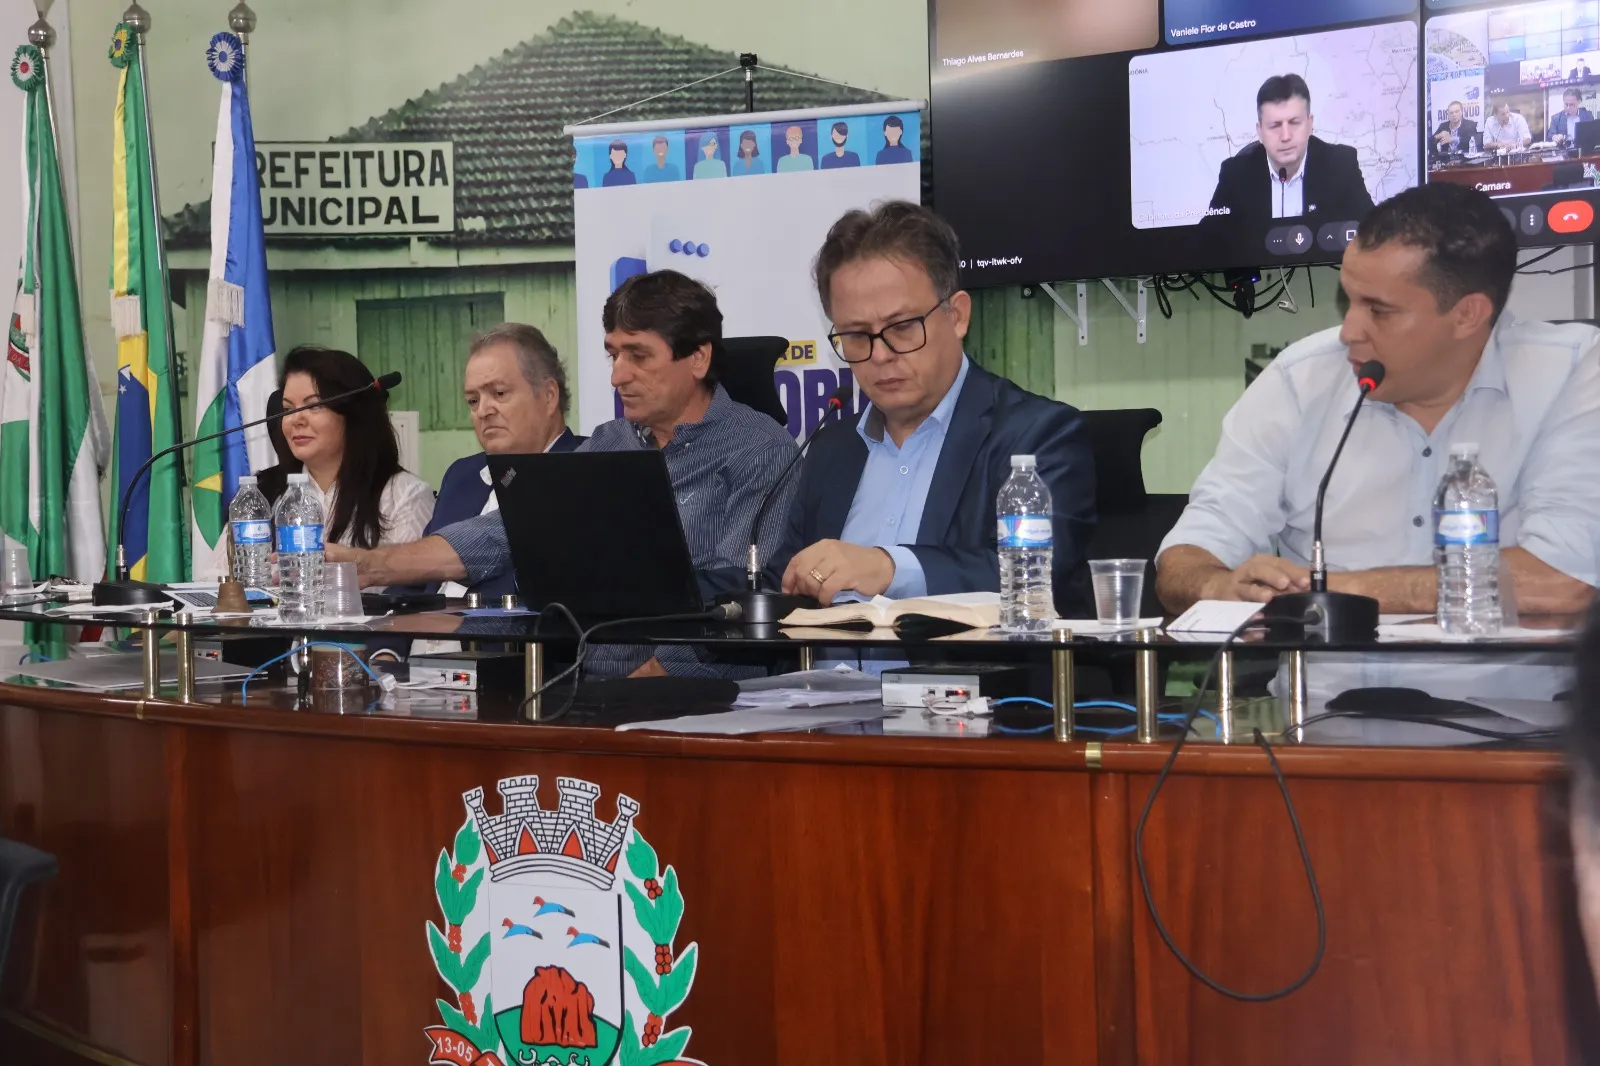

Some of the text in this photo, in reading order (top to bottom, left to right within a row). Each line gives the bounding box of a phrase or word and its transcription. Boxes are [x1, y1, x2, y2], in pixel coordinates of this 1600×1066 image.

[1170, 19, 1256, 37] Vaniele Flor de Castro
[943, 49, 1024, 67] Thiago Alves Bernardes
[255, 149, 449, 189] REFEITURA
[1475, 181, 1512, 192] Camara
[263, 195, 439, 226] UNICIPAL
[1185, 205, 1231, 218] Presidência
[791, 344, 814, 360] DE
[436, 1036, 474, 1062] 13-05
